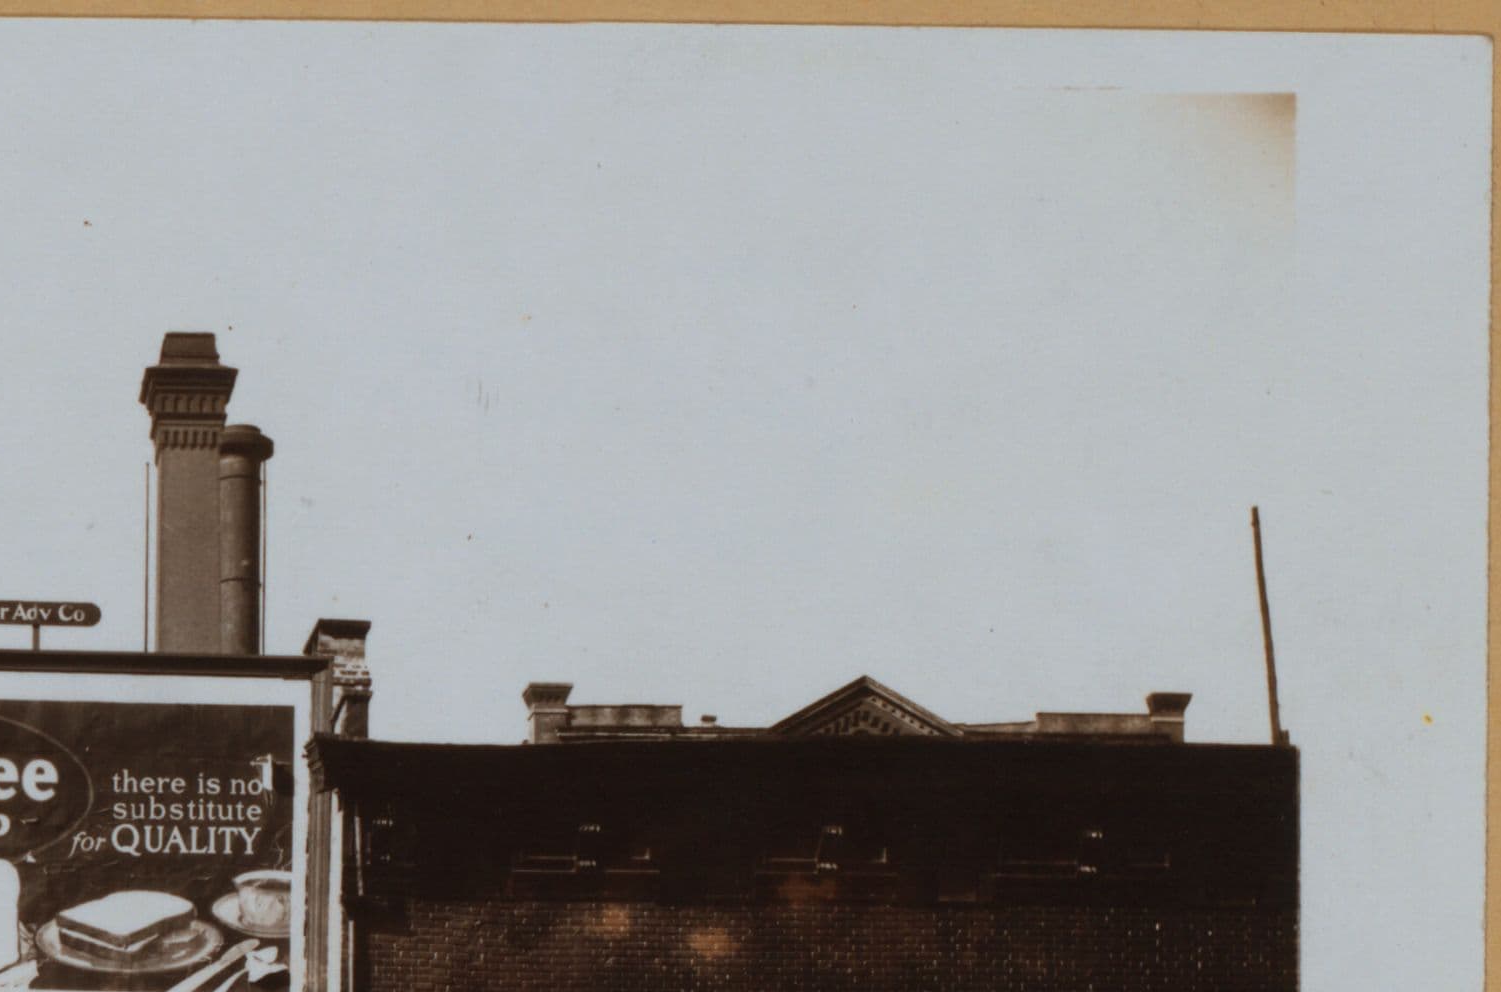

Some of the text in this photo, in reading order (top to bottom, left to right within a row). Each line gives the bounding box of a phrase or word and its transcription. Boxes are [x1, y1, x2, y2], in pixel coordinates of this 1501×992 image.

[12, 603, 51, 621] Adv
[58, 604, 85, 622] Co
[112, 769, 263, 796] there is no
[113, 796, 262, 821] substitute
[68, 823, 262, 858] for QUALITY
